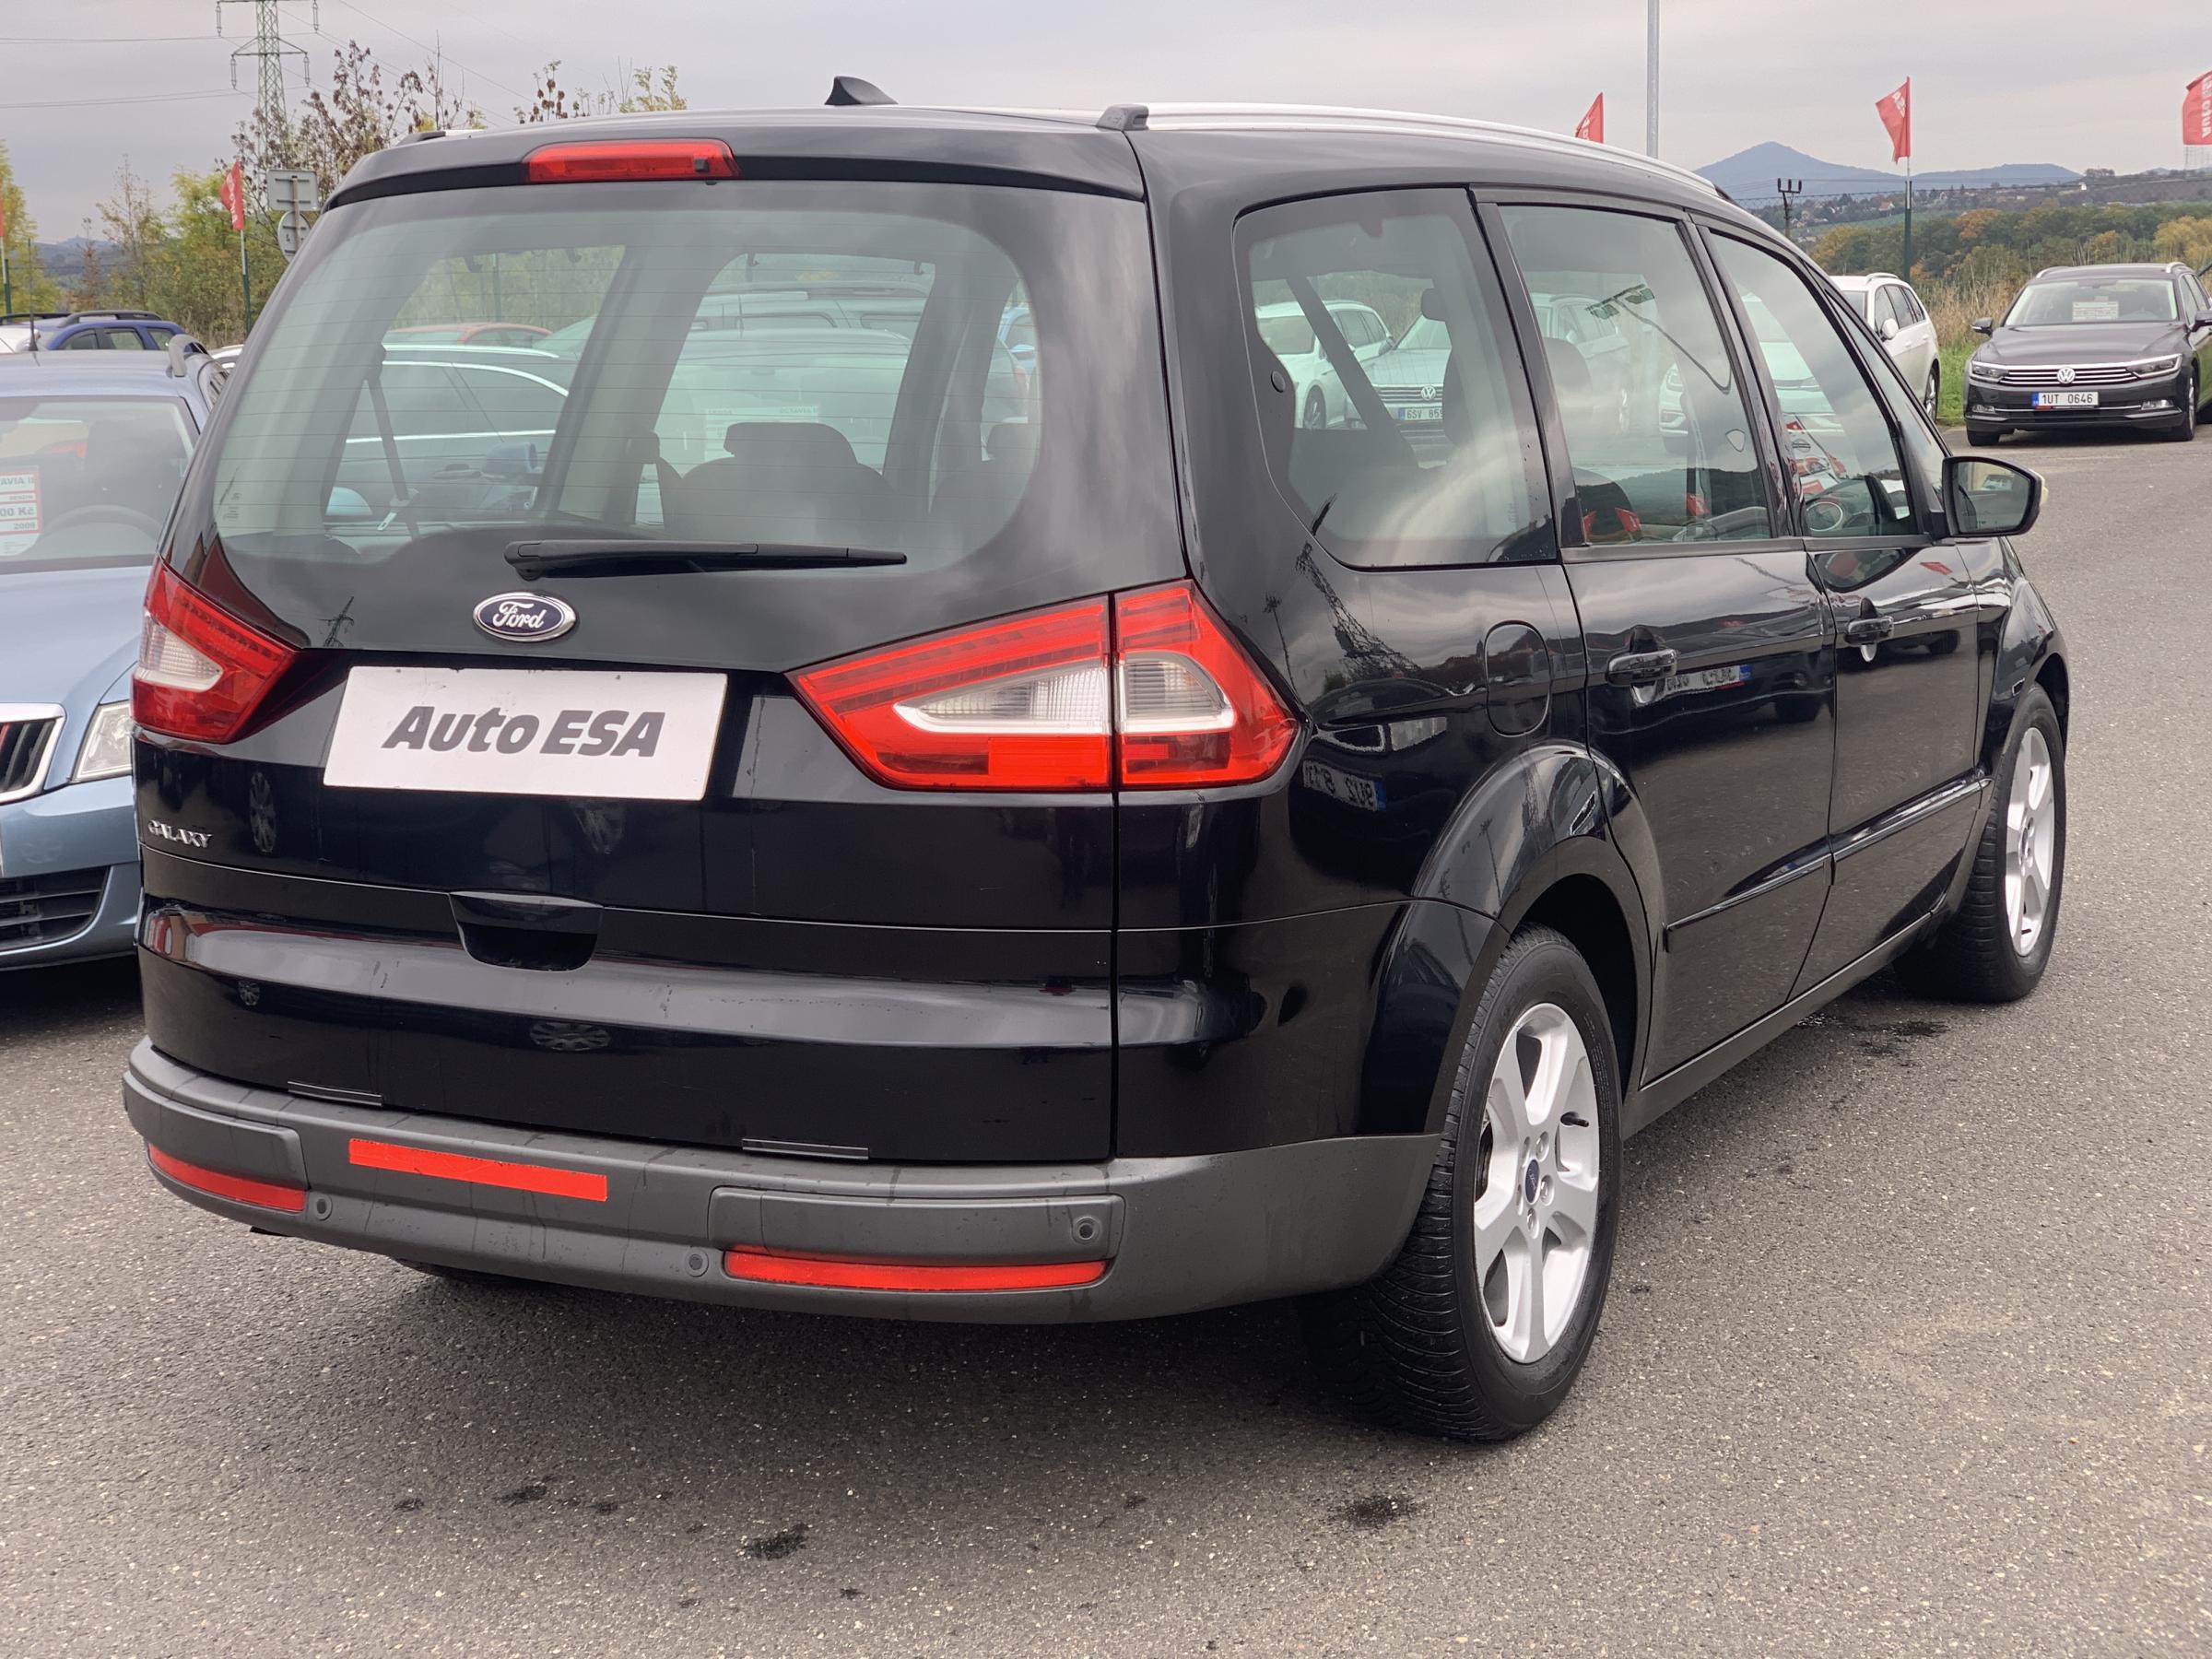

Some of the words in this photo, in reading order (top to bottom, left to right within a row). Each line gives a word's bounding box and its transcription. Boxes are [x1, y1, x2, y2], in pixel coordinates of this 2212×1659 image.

[2041, 394, 2060, 404] 1UT
[2067, 394, 2093, 404] 0646
[0, 477, 25, 486] AVIA
[0, 507, 14, 517] 00
[492, 601, 547, 629] Ford
[381, 706, 540, 754] Auto
[539, 710, 665, 757] ESA
[147, 819, 213, 848] GALAXY
